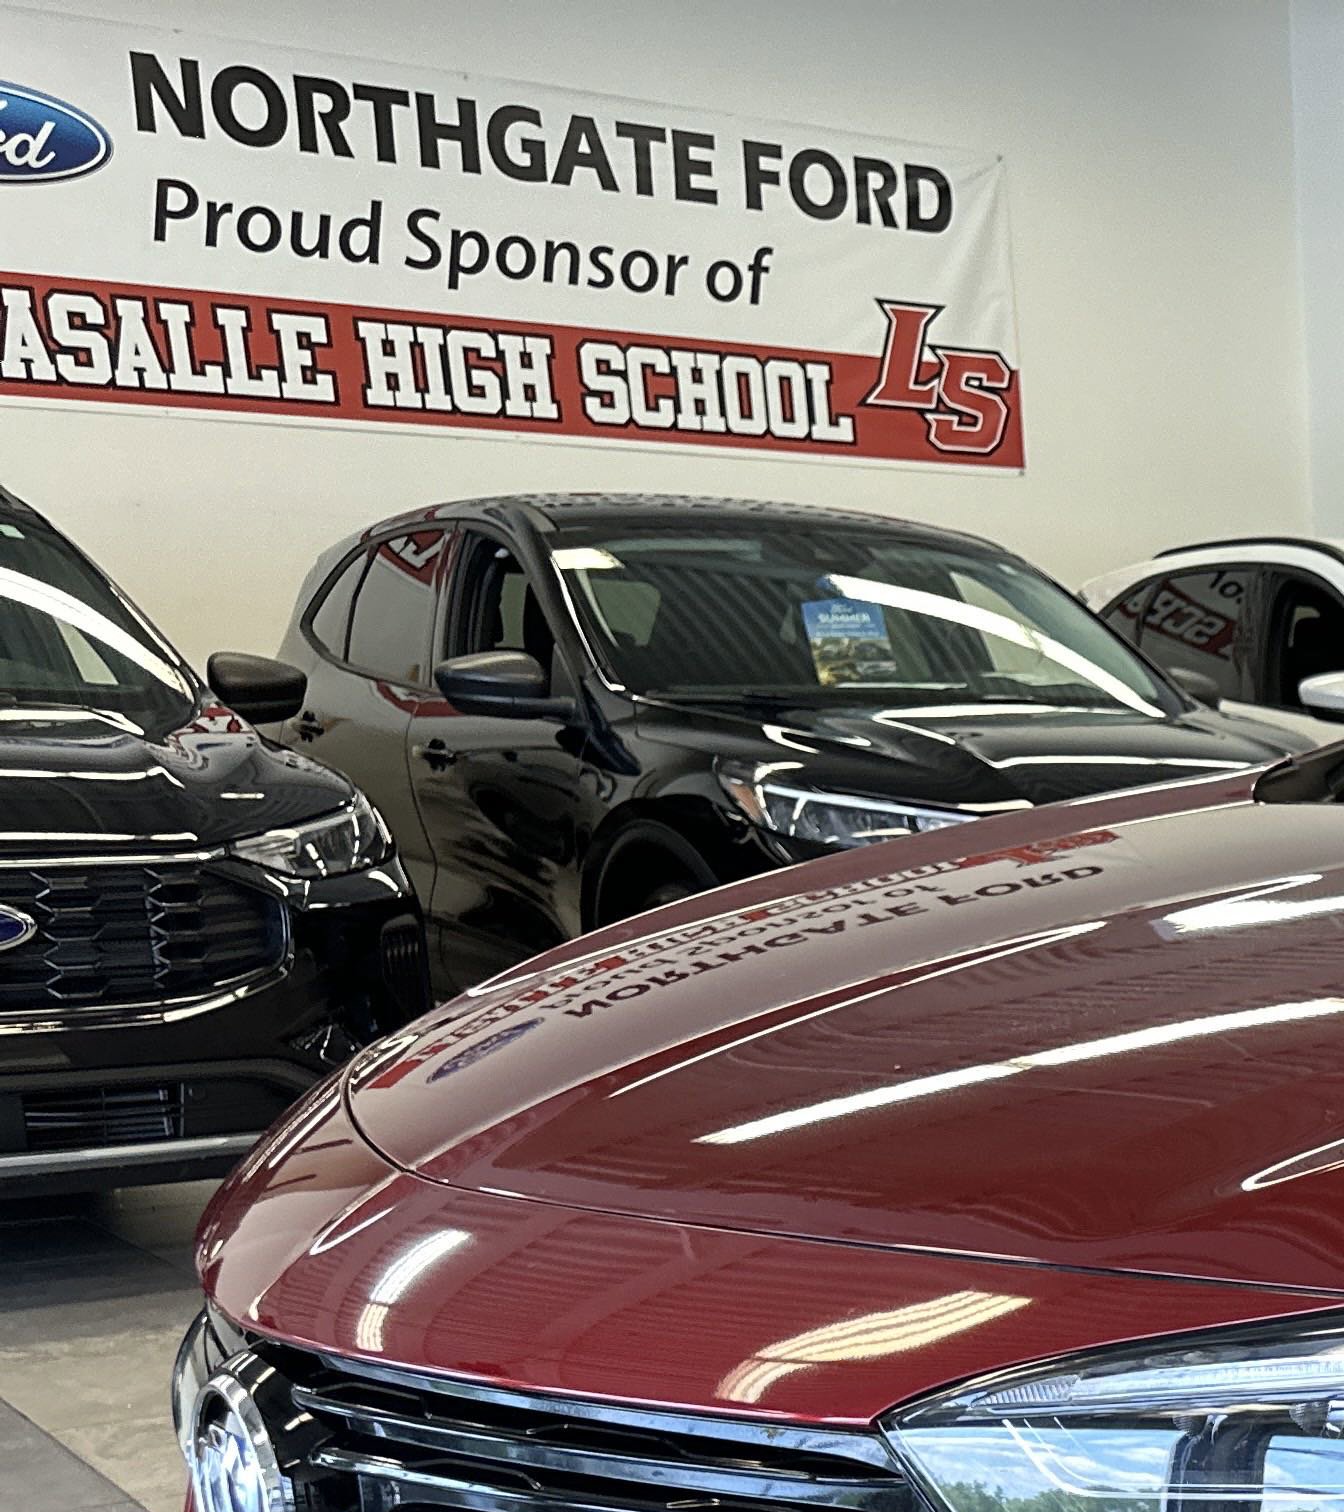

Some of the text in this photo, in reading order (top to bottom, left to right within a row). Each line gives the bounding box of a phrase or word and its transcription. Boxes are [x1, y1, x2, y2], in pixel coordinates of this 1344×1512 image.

[129, 50, 719, 206] NORTHGATE
[741, 139, 953, 235] FORD
[153, 178, 775, 306] Proud Sponsor of
[0, 286, 856, 443] ASALLE HIGH SCHOOL
[860, 298, 1011, 454] LS
